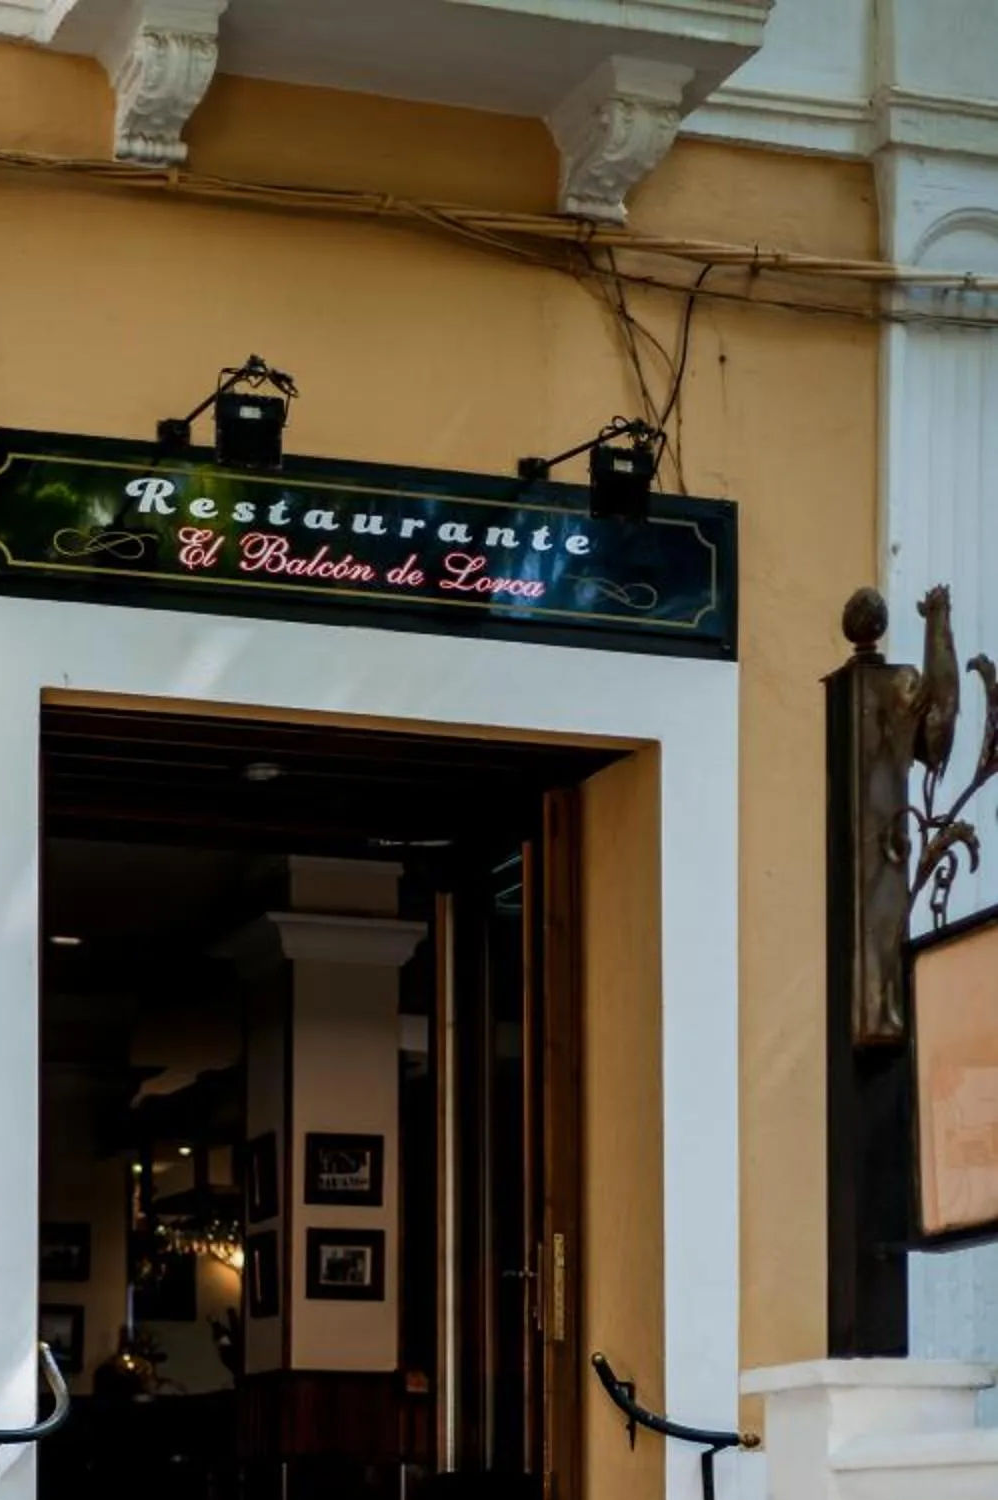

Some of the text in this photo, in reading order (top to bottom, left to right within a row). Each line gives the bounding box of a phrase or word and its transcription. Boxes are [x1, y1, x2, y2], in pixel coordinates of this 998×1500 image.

[124, 477, 591, 555] Restaurante
[178, 527, 547, 598] El Balcón de Lorca
